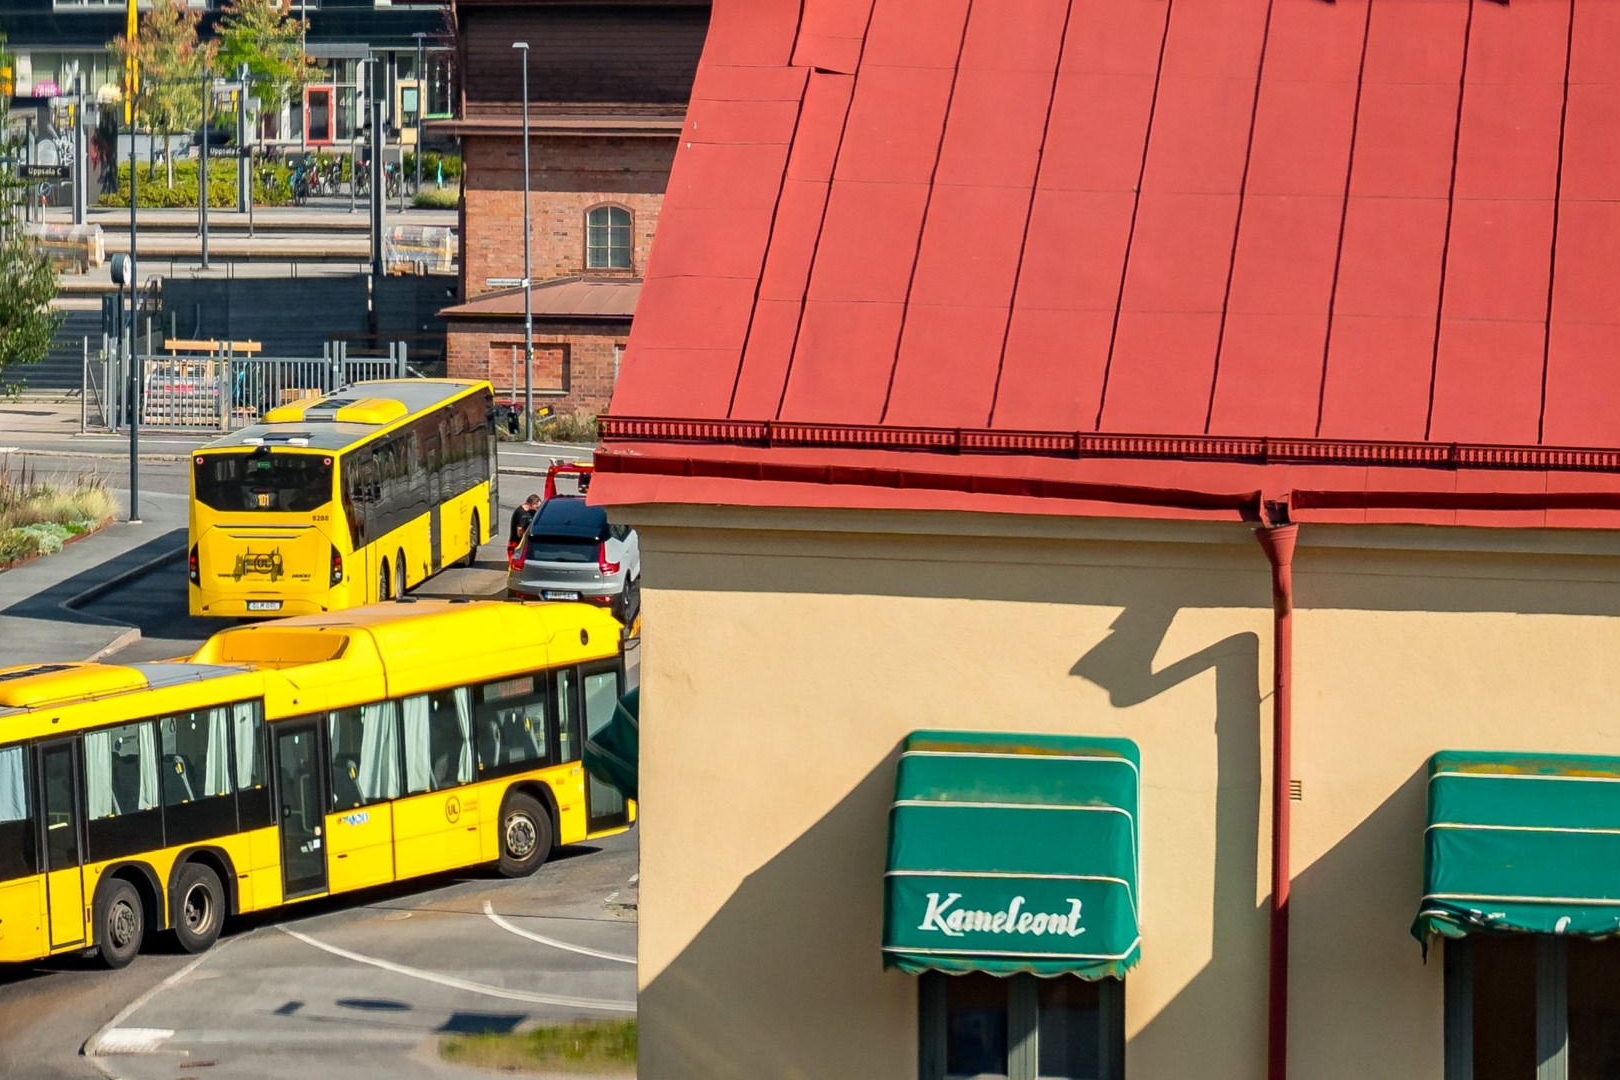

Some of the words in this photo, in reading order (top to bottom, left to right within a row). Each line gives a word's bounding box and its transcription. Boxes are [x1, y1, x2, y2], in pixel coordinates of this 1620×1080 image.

[339, 96, 352, 107] 44
[210, 146, 236, 157] Uppsala
[236, 146, 241, 156] C
[28, 167, 56, 177] Uppsala
[56, 167, 62, 176] C
[258, 493, 270, 507] 101
[447, 804, 458, 816] UL
